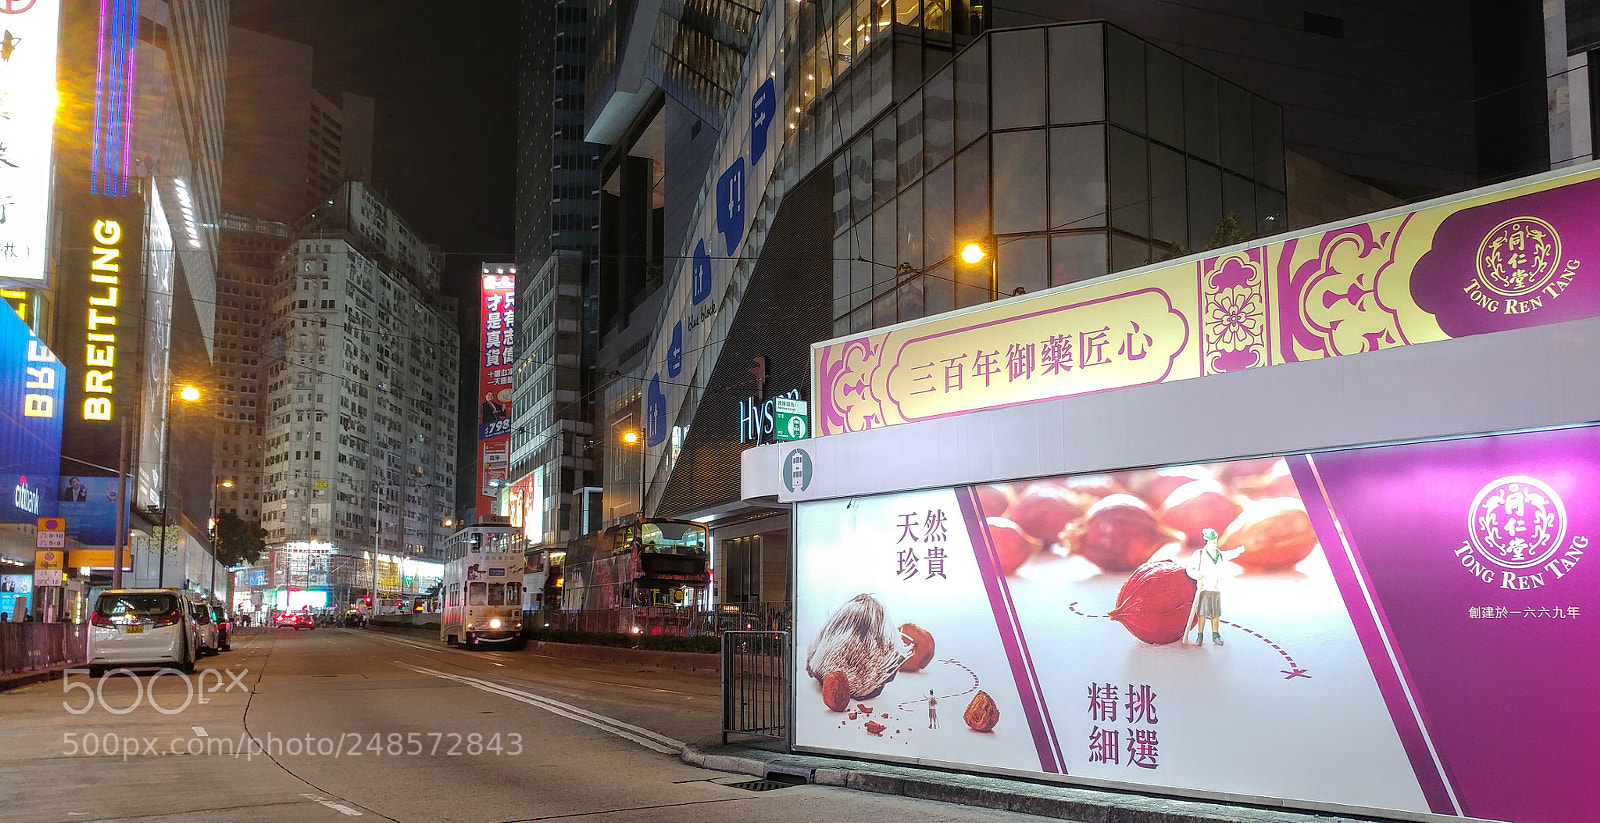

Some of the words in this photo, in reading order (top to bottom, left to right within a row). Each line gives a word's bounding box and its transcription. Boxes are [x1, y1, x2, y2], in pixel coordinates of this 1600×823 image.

[1463, 278, 1500, 313] TONG
[1503, 298, 1544, 315] REN
[1541, 259, 1581, 300] TANG
[1507, 230, 1529, 290] 同仁堂
[83, 218, 122, 421] BREITLING
[486, 293, 502, 368] 才是真貨
[687, 315, 700, 333] blue
[909, 320, 1154, 397] 三百年御藥匠心
[485, 418, 510, 435] $798
[896, 508, 948, 545] 天然
[1504, 491, 1528, 561] 同仁堂
[896, 546, 948, 581] 珍貴
[1453, 540, 1495, 584] TONG
[1500, 571, 1545, 591] REN
[1544, 535, 1589, 580] TANG
[1468, 606, 1581, 620] 創建於一六六九年
